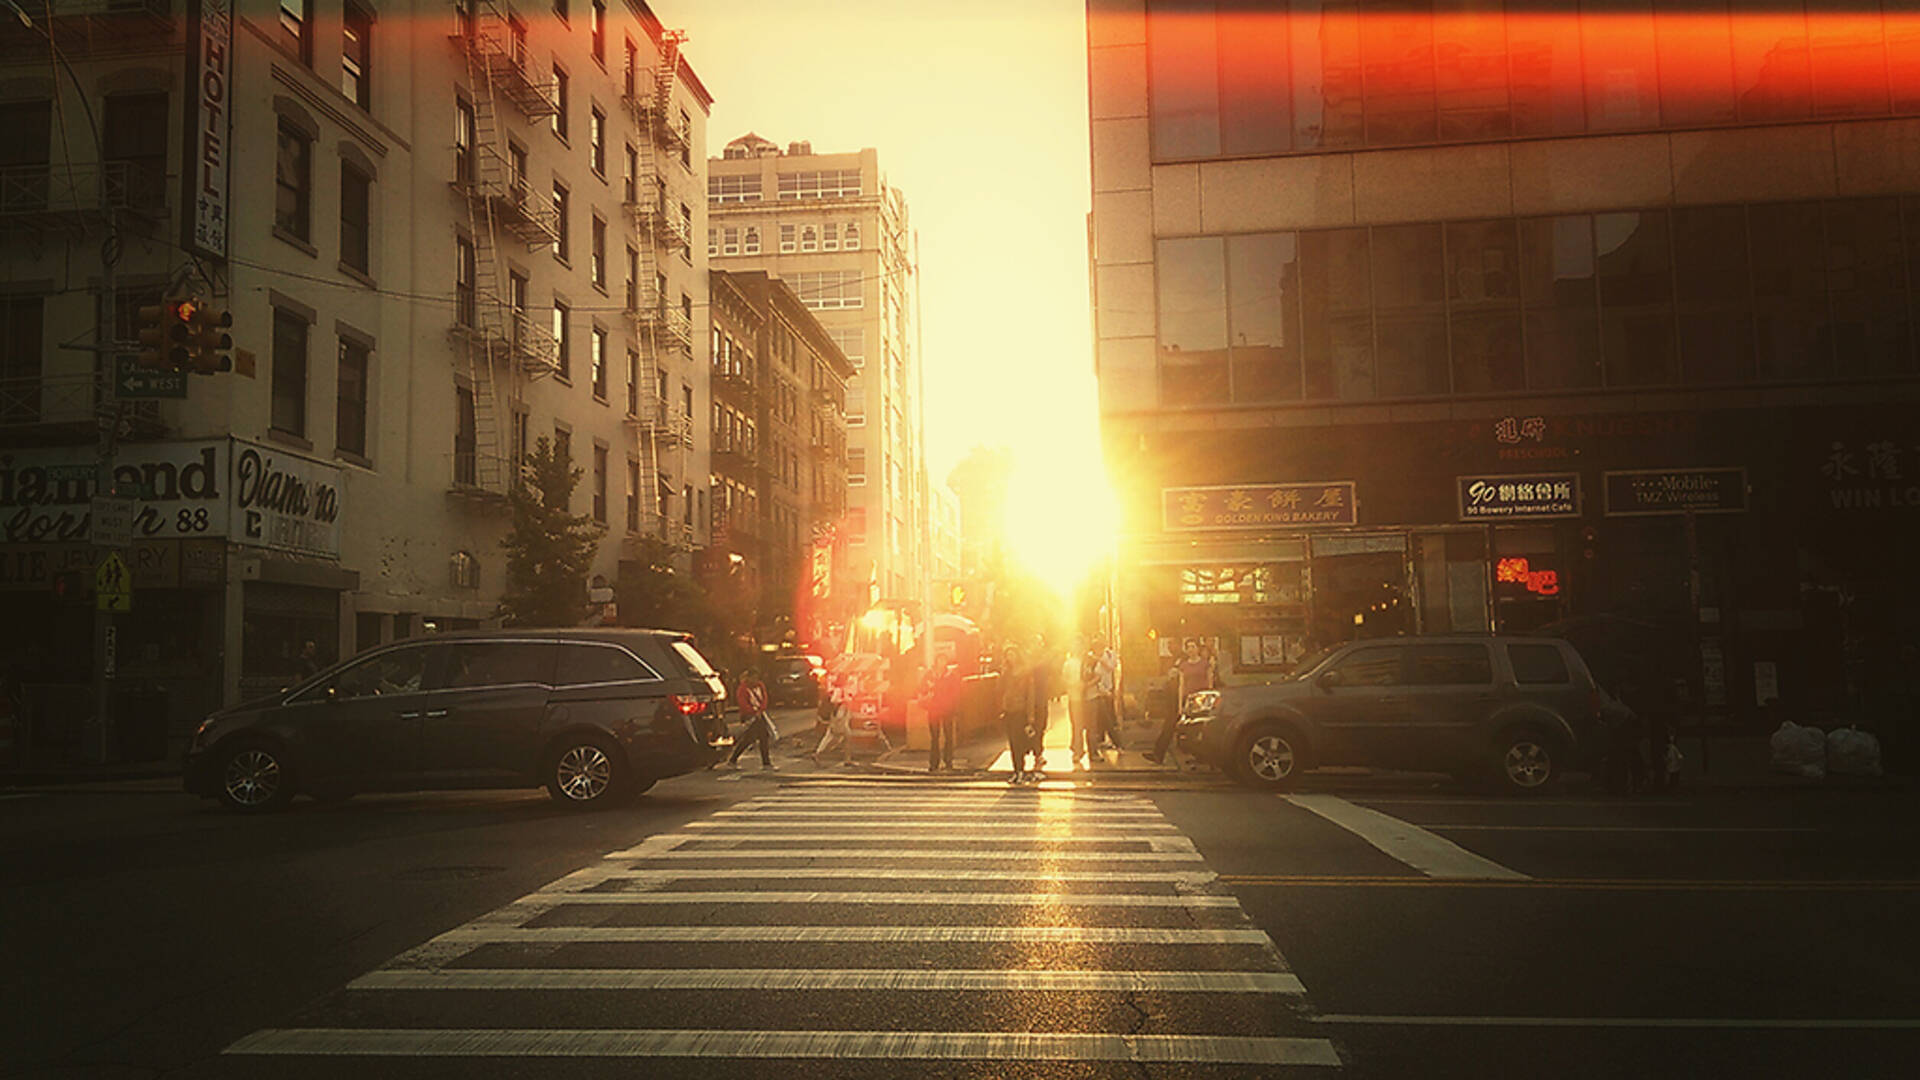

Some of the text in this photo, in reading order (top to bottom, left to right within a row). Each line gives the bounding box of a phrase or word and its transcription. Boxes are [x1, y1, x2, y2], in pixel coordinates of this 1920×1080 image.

[202, 35, 224, 199] HOTEL
[148, 378, 182, 393] WEST
[1818, 440, 1920, 481] 永隆
[1468, 480, 1497, 505] 90
[1830, 487, 1881, 508] WIN
[176, 507, 209, 533] 88
[1215, 510, 1340, 525] GOLDEN KING BAKERY
[1479, 504, 1514, 516] Bowery
[1514, 503, 1550, 514] Internet
